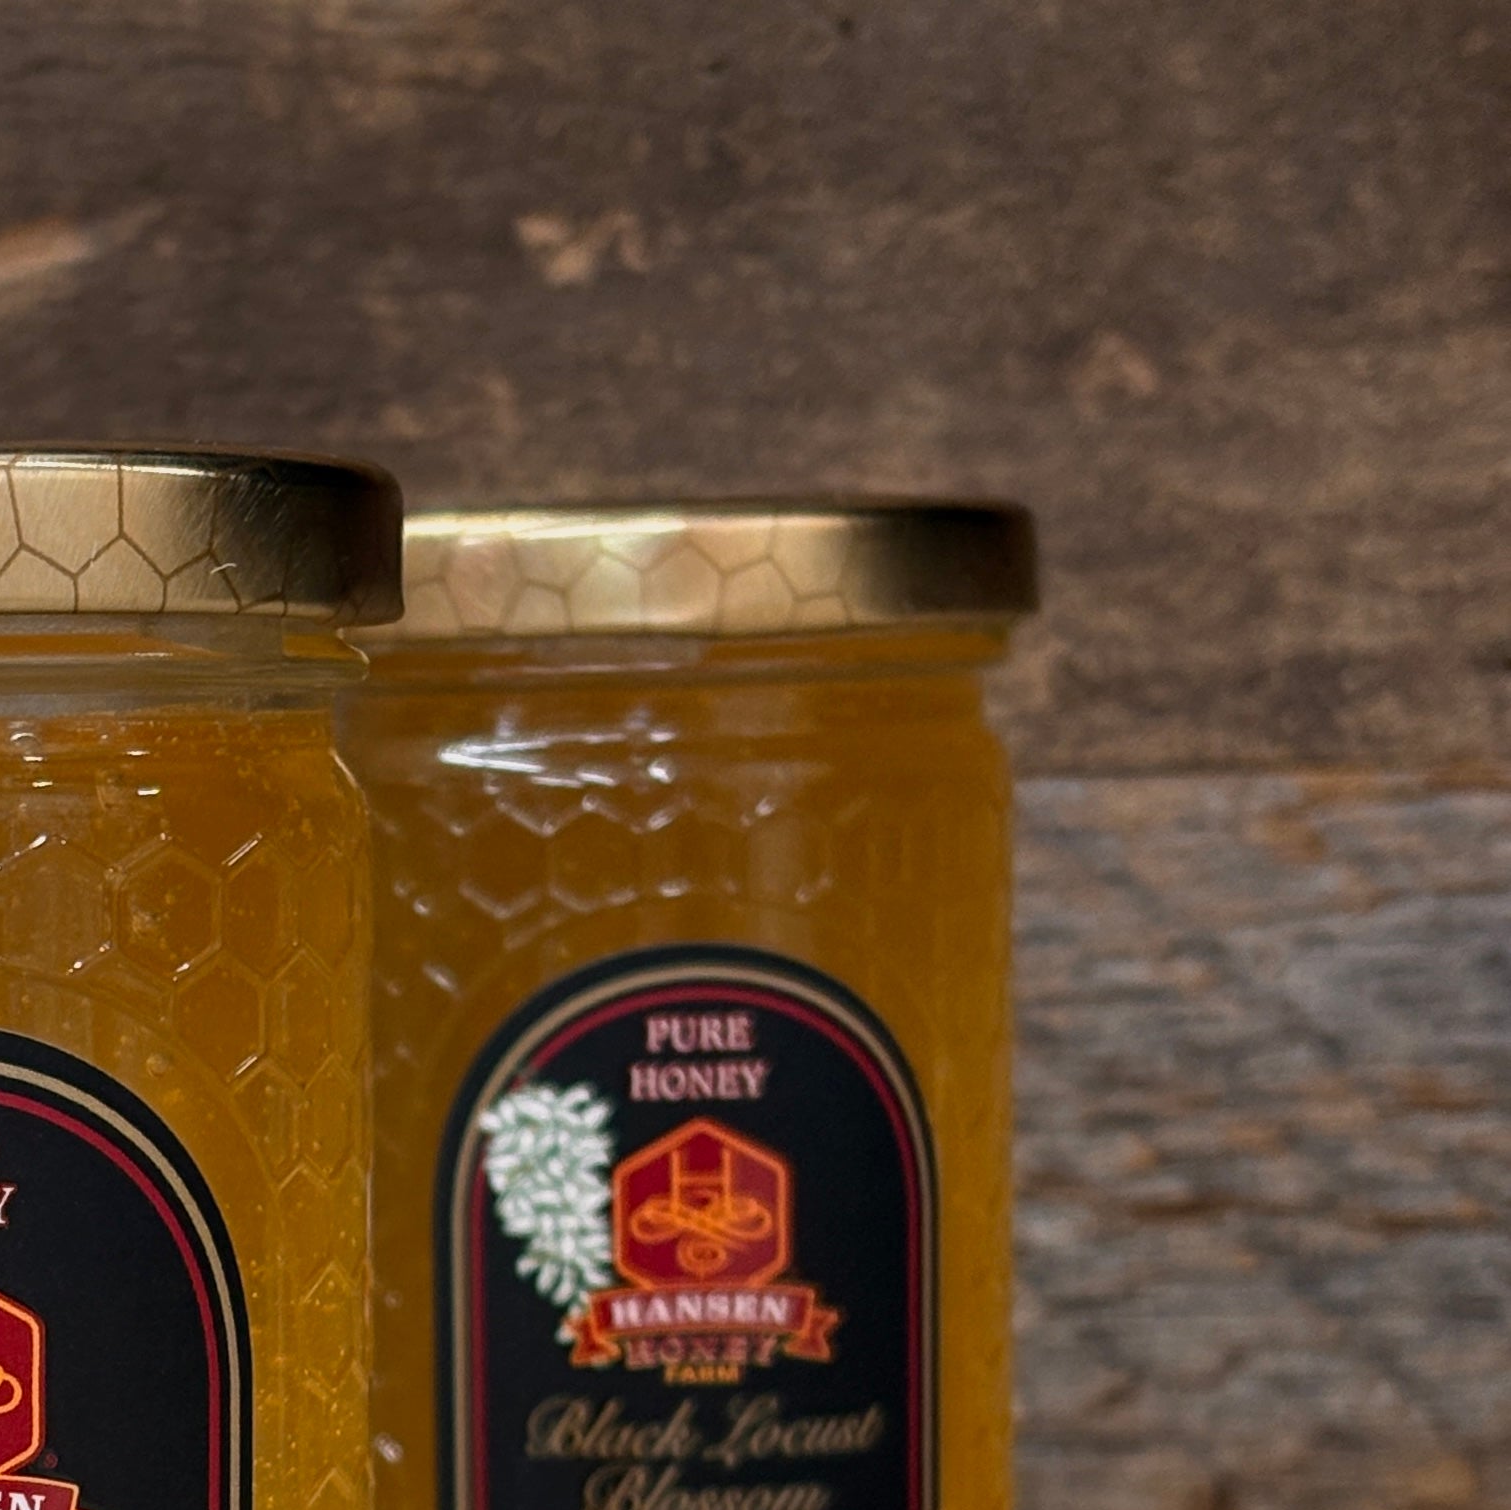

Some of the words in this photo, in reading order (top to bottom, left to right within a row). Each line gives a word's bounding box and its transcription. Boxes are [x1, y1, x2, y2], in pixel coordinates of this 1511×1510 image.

[645, 1011, 755, 1053] PURE
[630, 1060, 771, 1100] HONEY
[610, 1293, 789, 1328] HANSEN
[624, 1335, 781, 1368] HONEY
[664, 1364, 743, 1385] FARM
